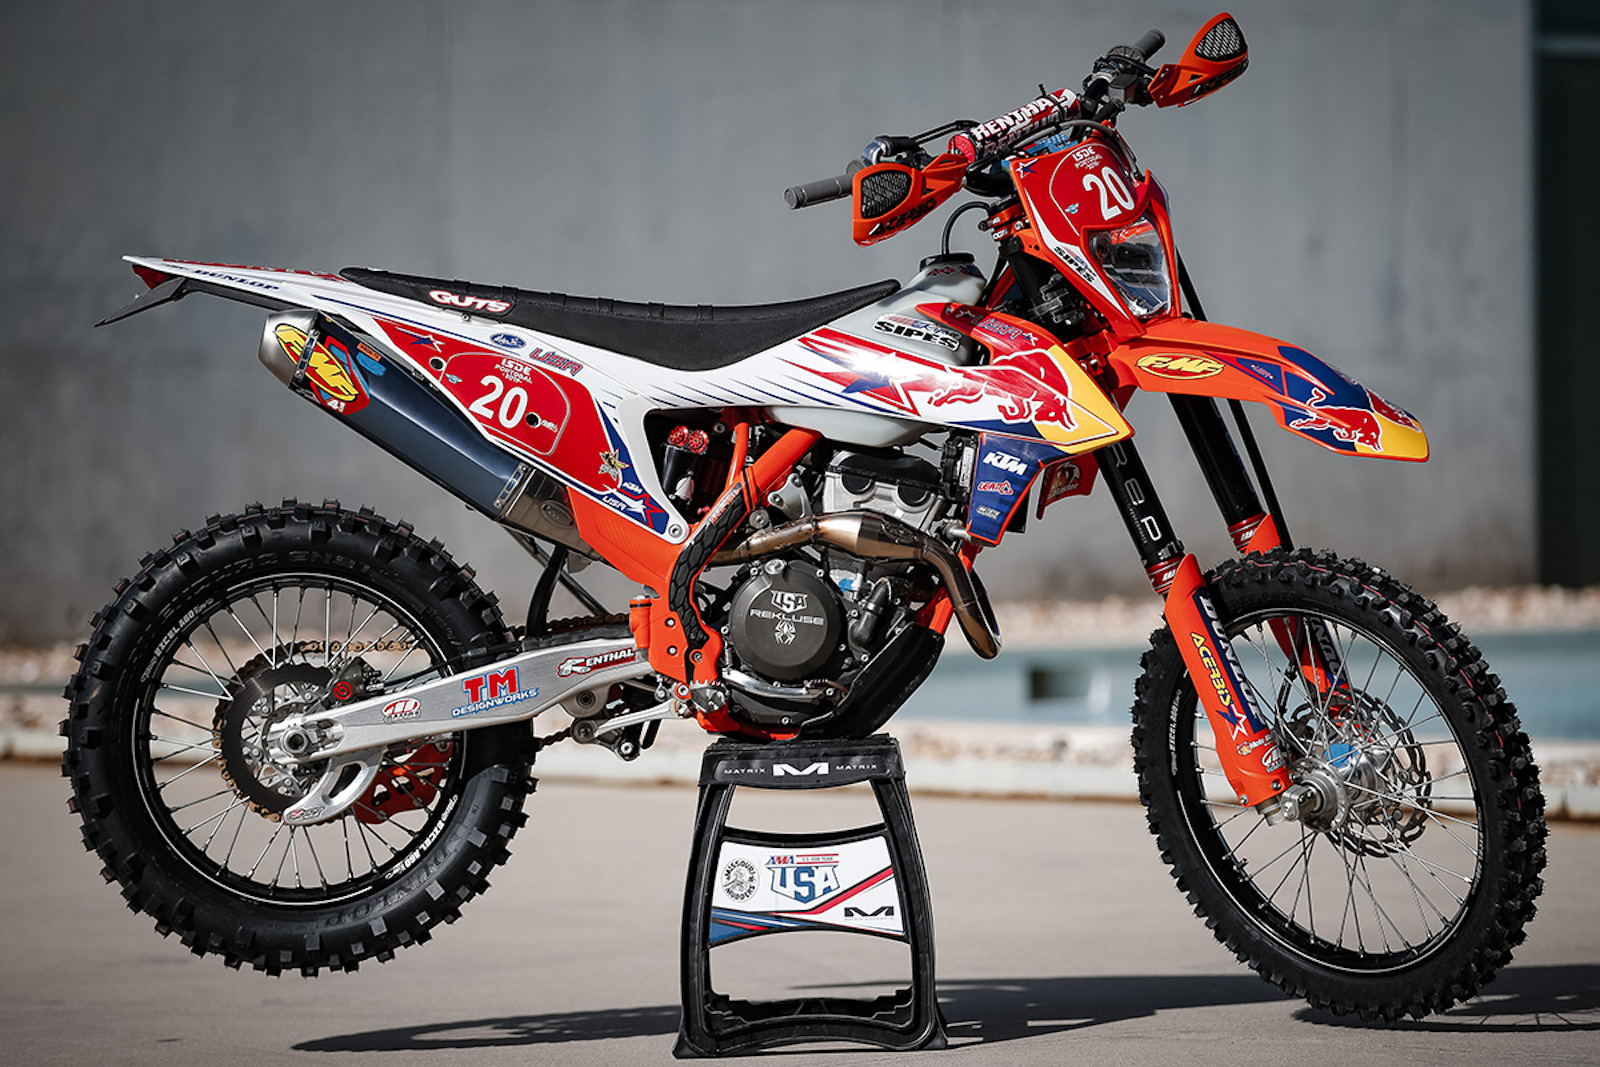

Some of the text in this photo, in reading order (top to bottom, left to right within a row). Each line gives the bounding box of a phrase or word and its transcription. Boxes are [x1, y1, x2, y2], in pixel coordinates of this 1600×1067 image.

[970, 93, 1066, 141] RENTHAL
[1072, 146, 1095, 161] ISDE
[1082, 166, 1135, 221] 20
[1054, 246, 1094, 282] SIPES
[194, 269, 279, 290] DUNLOP
[428, 290, 511, 313] GUTS
[874, 321, 958, 349] SIPES
[970, 315, 1023, 341] USA
[501, 358, 532, 376] ISDE
[529, 348, 584, 376] USA
[1134, 355, 1226, 374] FMF
[468, 375, 528, 428] 20
[983, 451, 1028, 476] KTM
[602, 495, 627, 511] USA
[771, 590, 808, 613] USA
[750, 608, 824, 626] REKLUSE
[154, 626, 180, 657] EXCEL
[559, 649, 634, 676] RENTHAL
[1190, 632, 1232, 707] ACERBIS
[463, 667, 518, 703] TM
[452, 689, 538, 716] DESIGNWORKS
[724, 767, 765, 775] MATRIX
[836, 764, 877, 772] MATRIX
[419, 820, 445, 851] EXCEL
[724, 861, 756, 881] MISSOURI
[765, 855, 795, 866] AMA
[771, 866, 840, 904] USA
